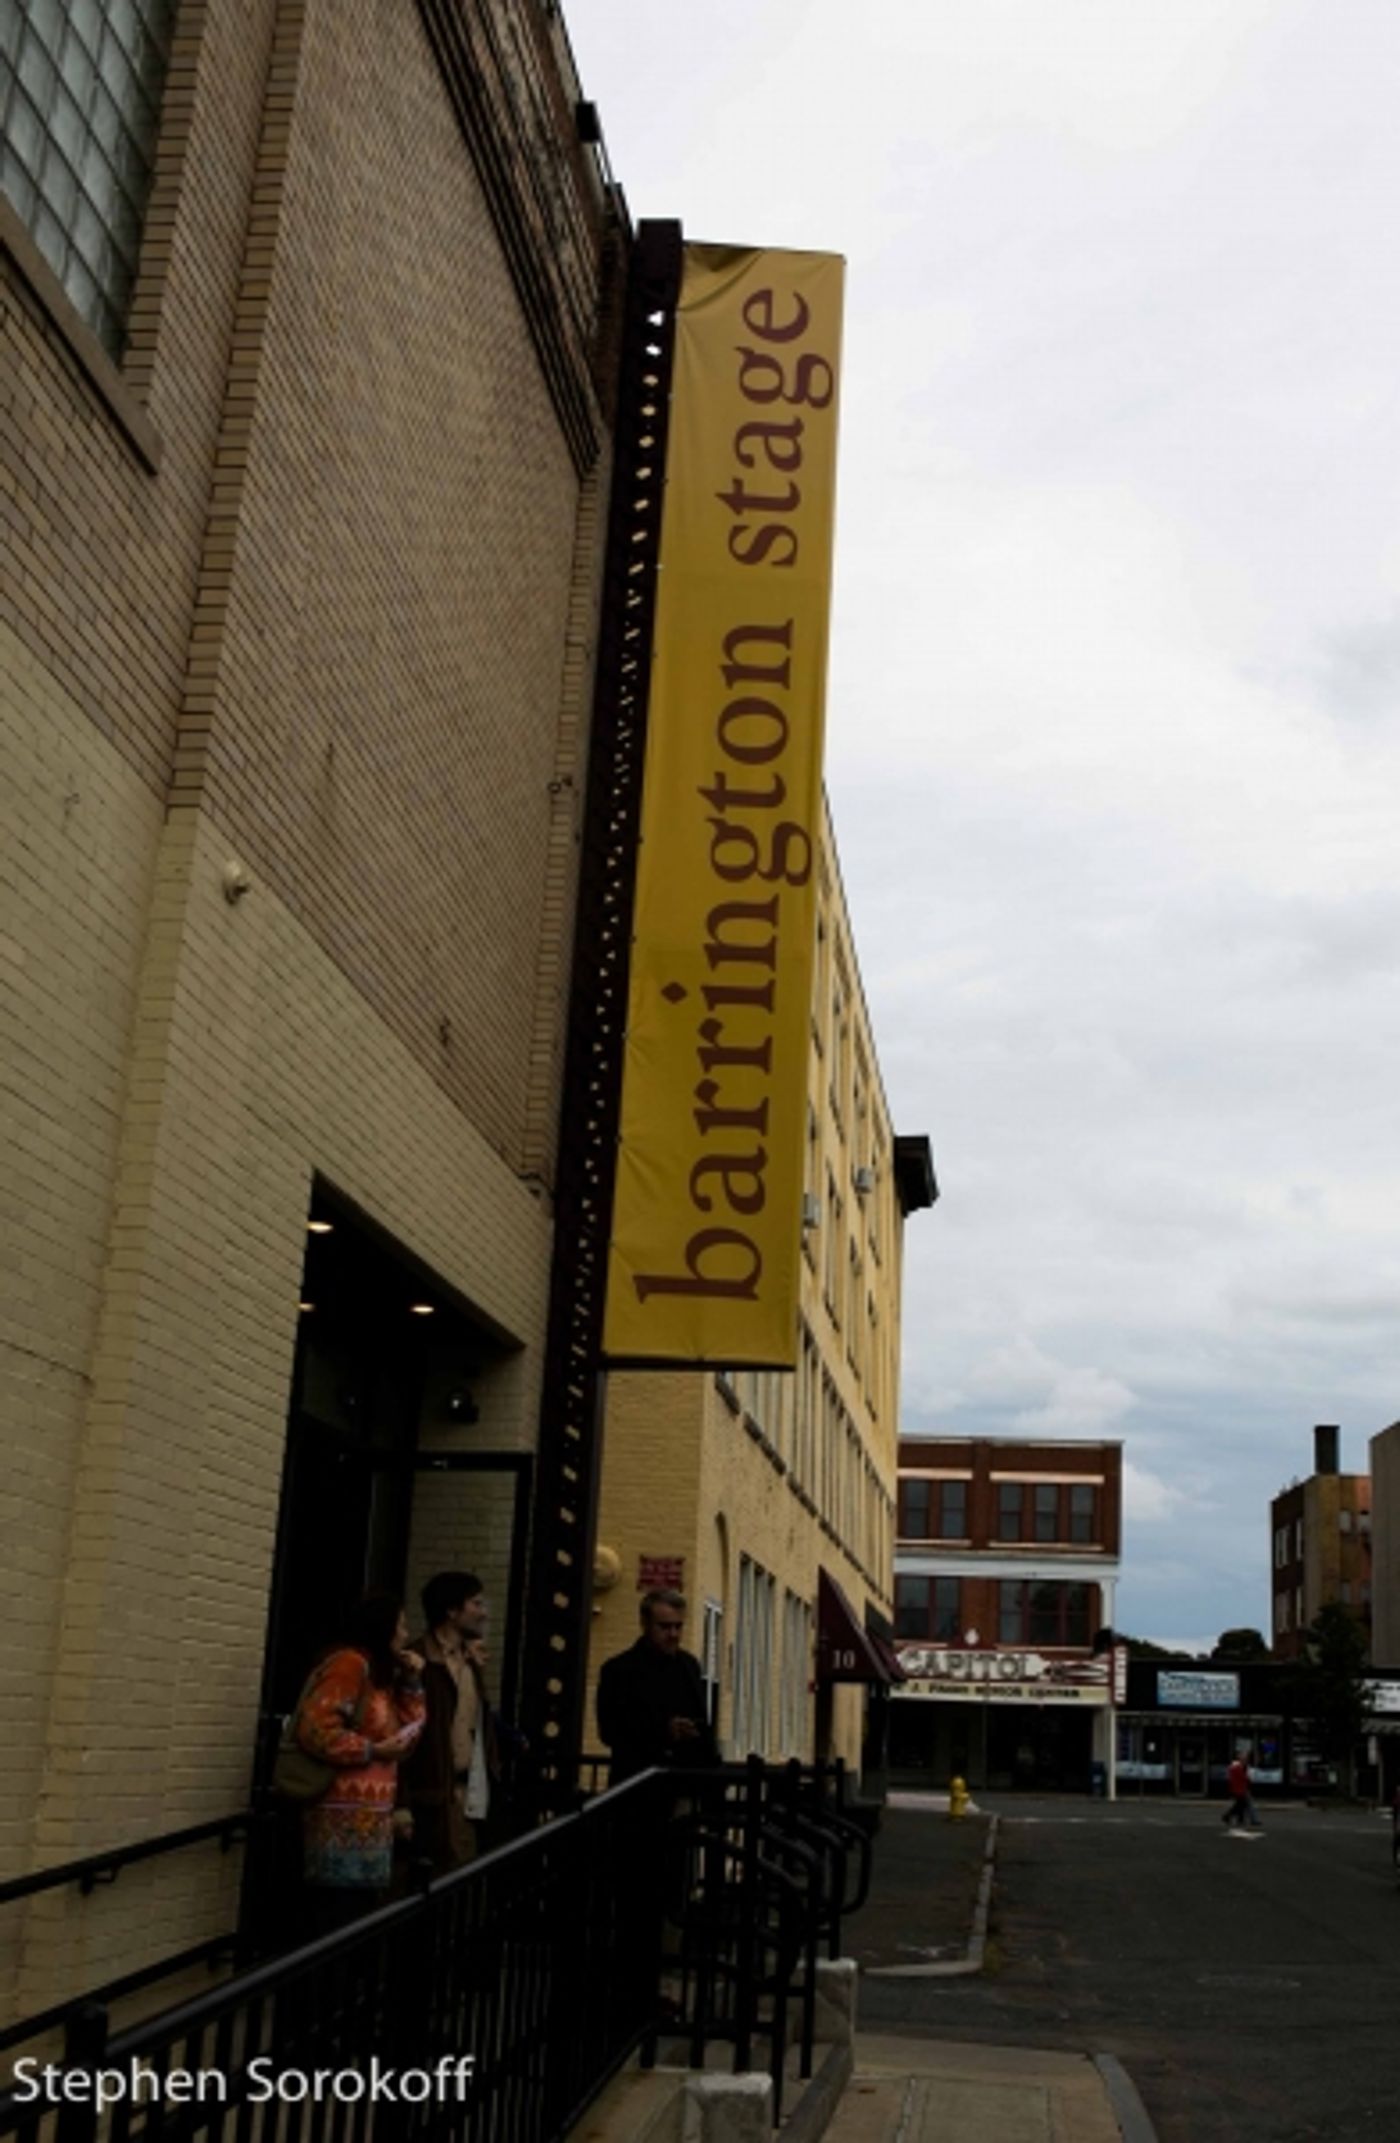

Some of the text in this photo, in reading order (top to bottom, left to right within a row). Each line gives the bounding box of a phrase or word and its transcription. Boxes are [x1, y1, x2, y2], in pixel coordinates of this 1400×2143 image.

[632, 288, 834, 1302] barrington stage
[833, 1649, 856, 1670] 10
[902, 1651, 1038, 1681] CAPITOL
